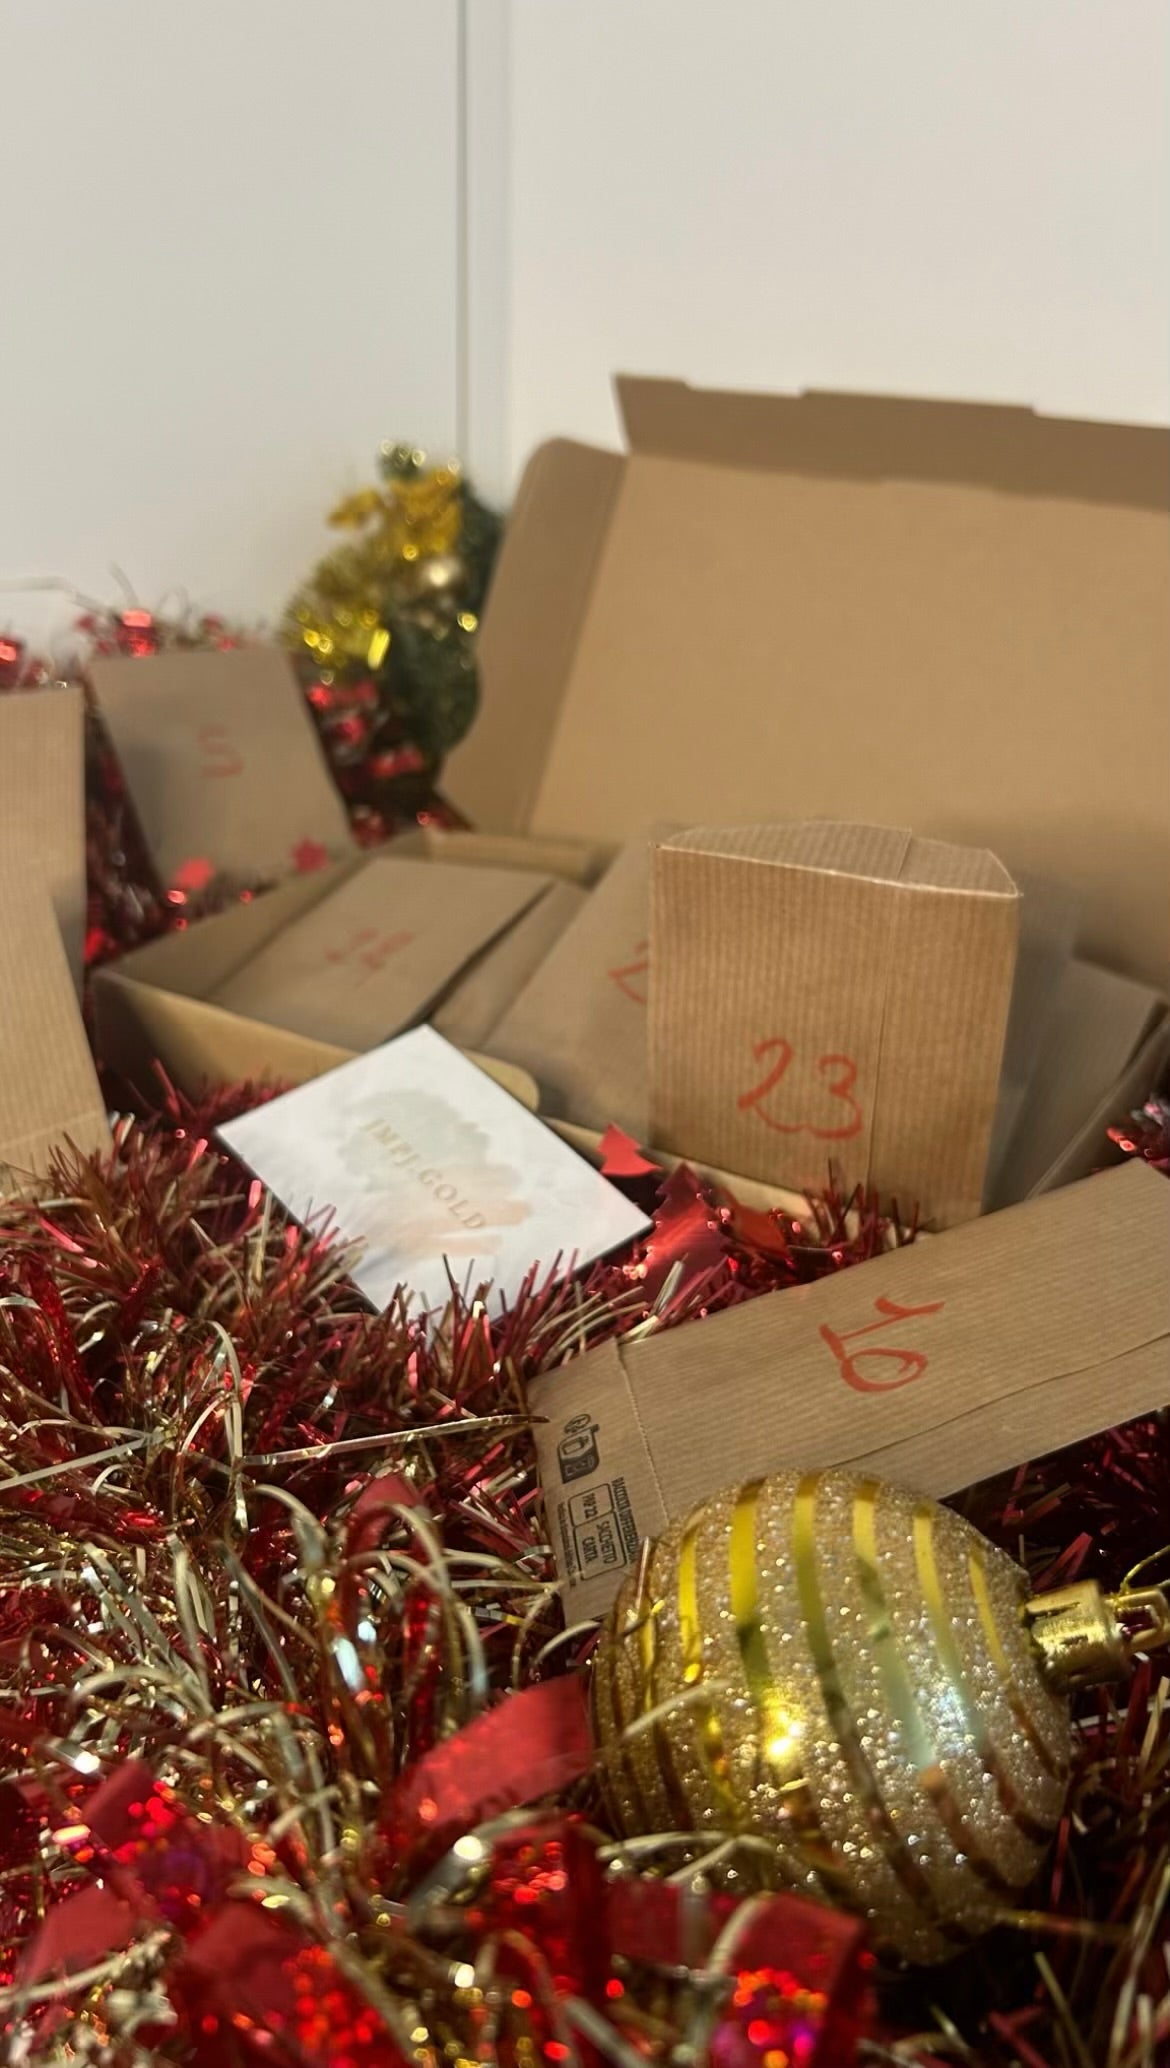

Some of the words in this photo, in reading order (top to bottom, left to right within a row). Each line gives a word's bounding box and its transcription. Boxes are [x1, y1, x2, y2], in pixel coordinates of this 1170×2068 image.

[737, 1036, 863, 1140] 23
[819, 1296, 946, 1391] 10
[582, 1535, 598, 1564] CARTA
[596, 1520, 618, 1564] SACCHETTO
